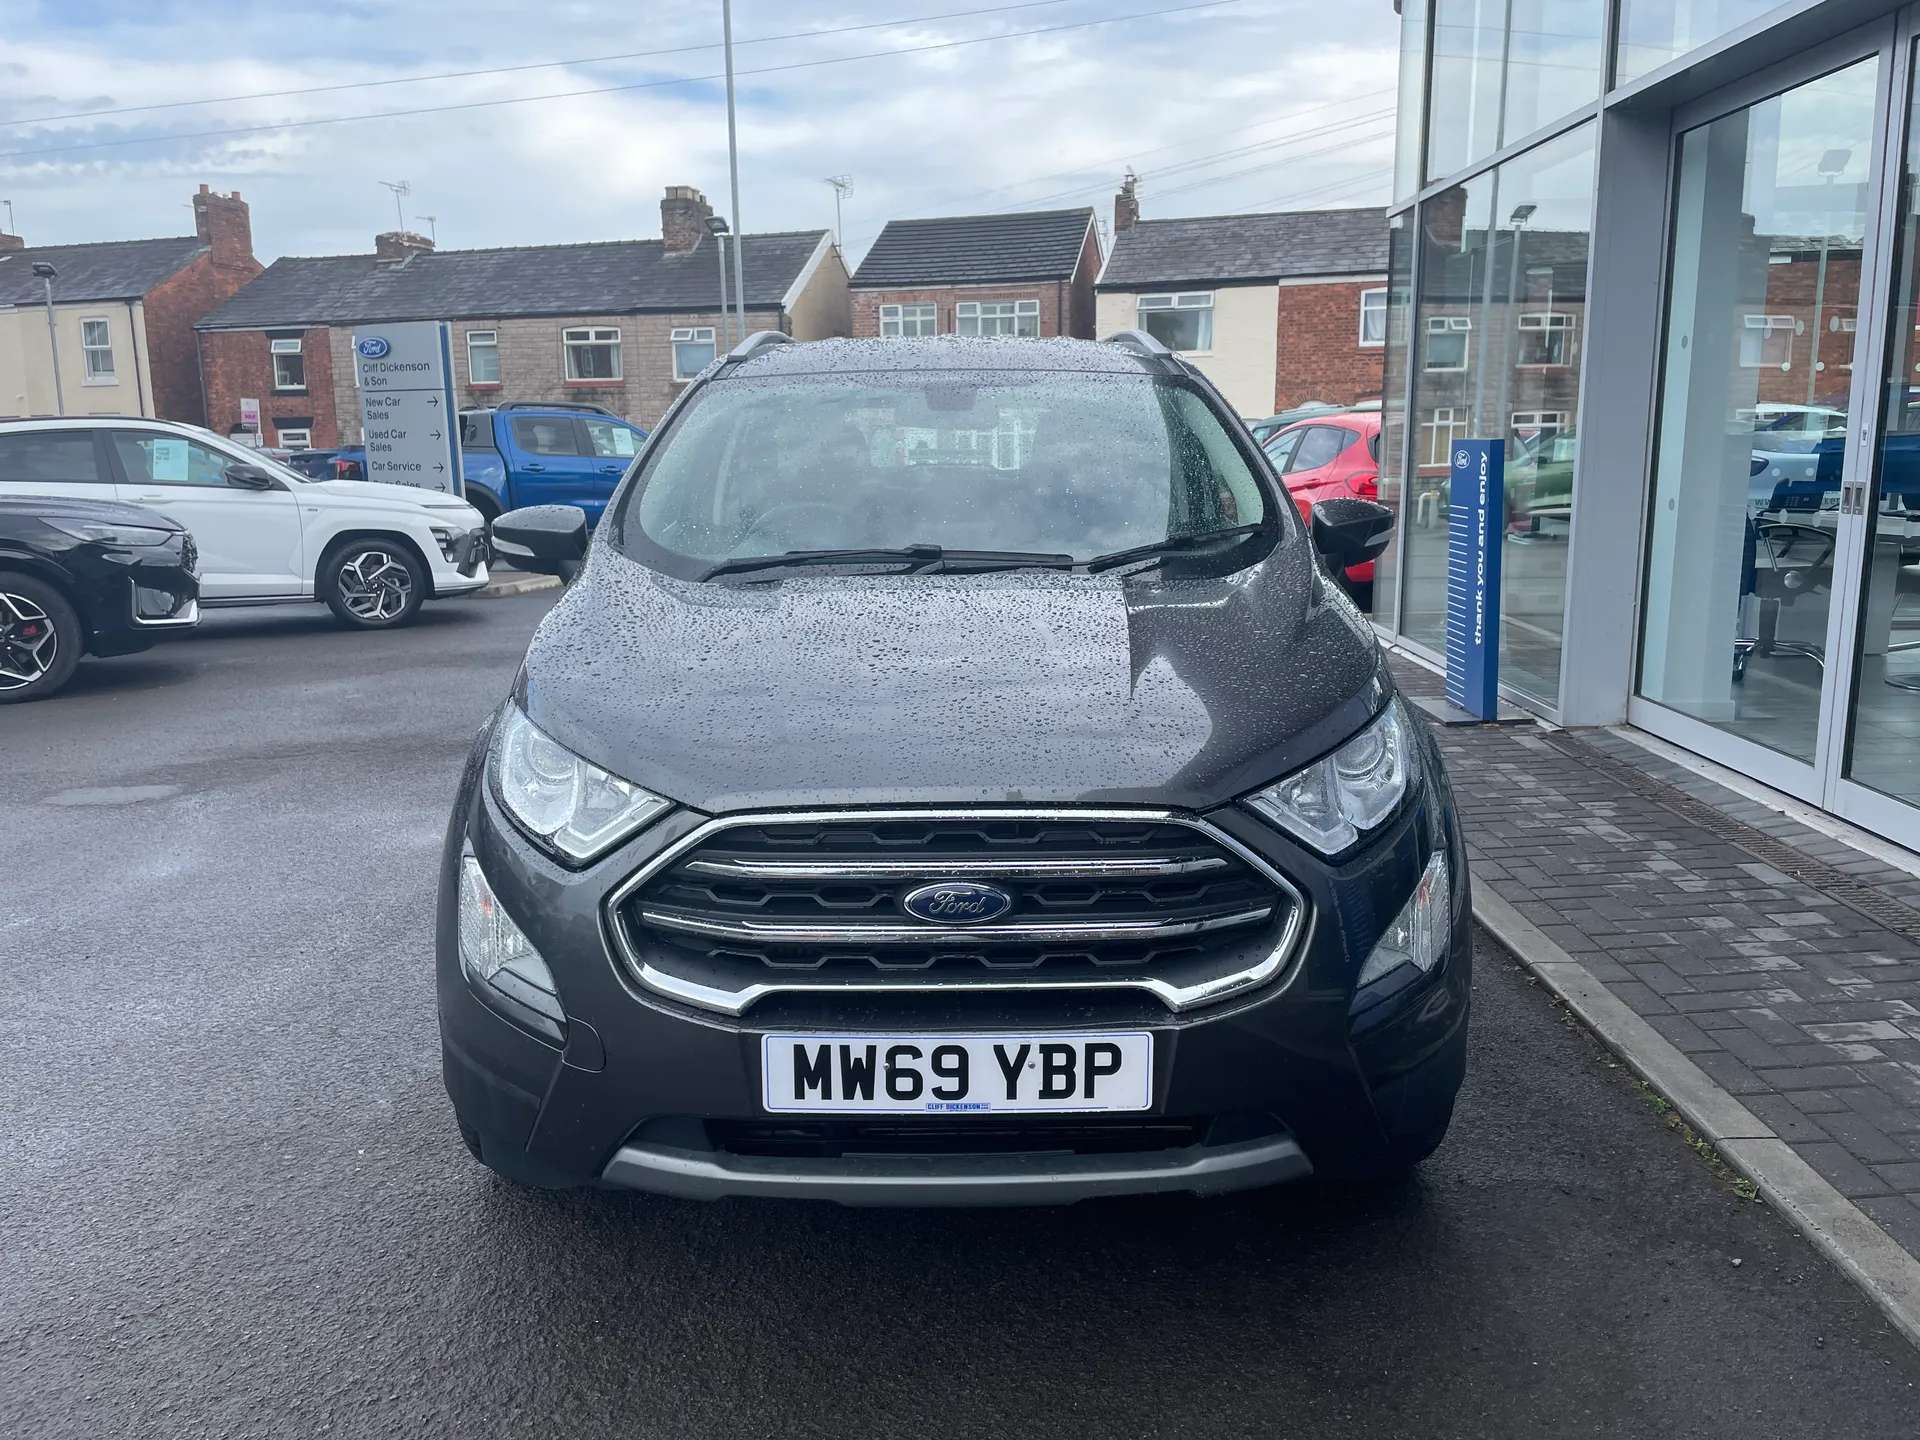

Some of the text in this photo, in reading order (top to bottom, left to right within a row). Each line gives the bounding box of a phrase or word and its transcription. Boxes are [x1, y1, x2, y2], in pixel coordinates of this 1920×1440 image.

[363, 340, 382, 354] Ford
[362, 362, 430, 373] Cliff Dickenson
[364, 376, 388, 386] & Son
[365, 396, 401, 407] New Car
[367, 410, 390, 420] Sales
[368, 429, 407, 439] Used Car
[370, 442, 393, 452] Sales
[372, 461, 422, 471] Car Service
[1479, 451, 1488, 506] enjoy
[1477, 549, 1485, 587] you
[1474, 589, 1483, 646] thank
[929, 890, 987, 914] Ford
[793, 1042, 1122, 1101] MW69 YBP
